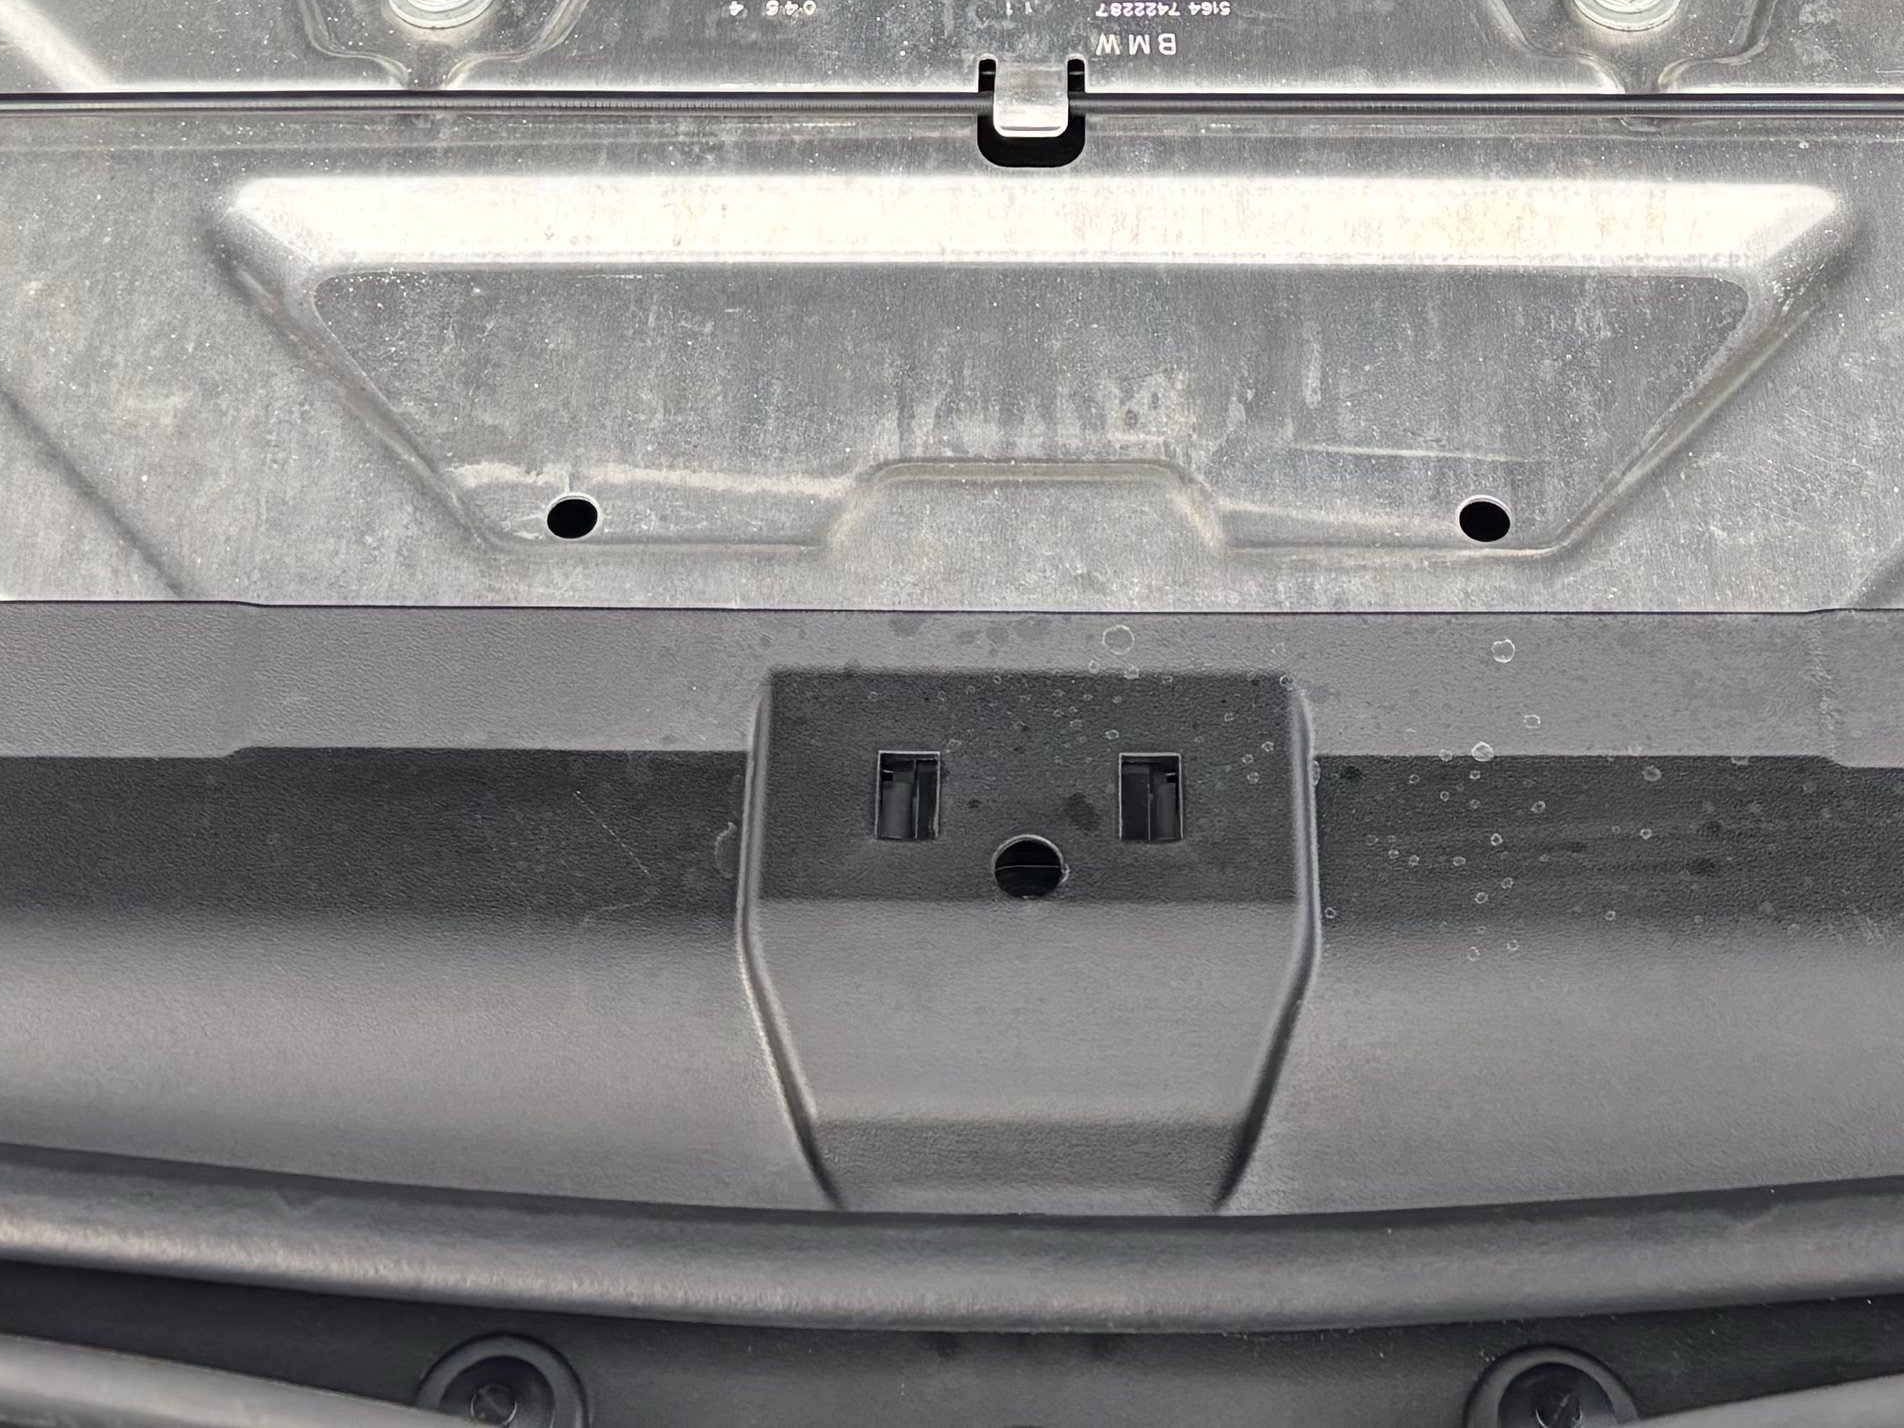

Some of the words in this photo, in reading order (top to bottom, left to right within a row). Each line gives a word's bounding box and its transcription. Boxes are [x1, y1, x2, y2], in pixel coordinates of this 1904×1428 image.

[1095, 1, 1179, 16] 7422287
[1188, 0, 1230, 15] 5164
[1093, 31, 1176, 55] BMW
